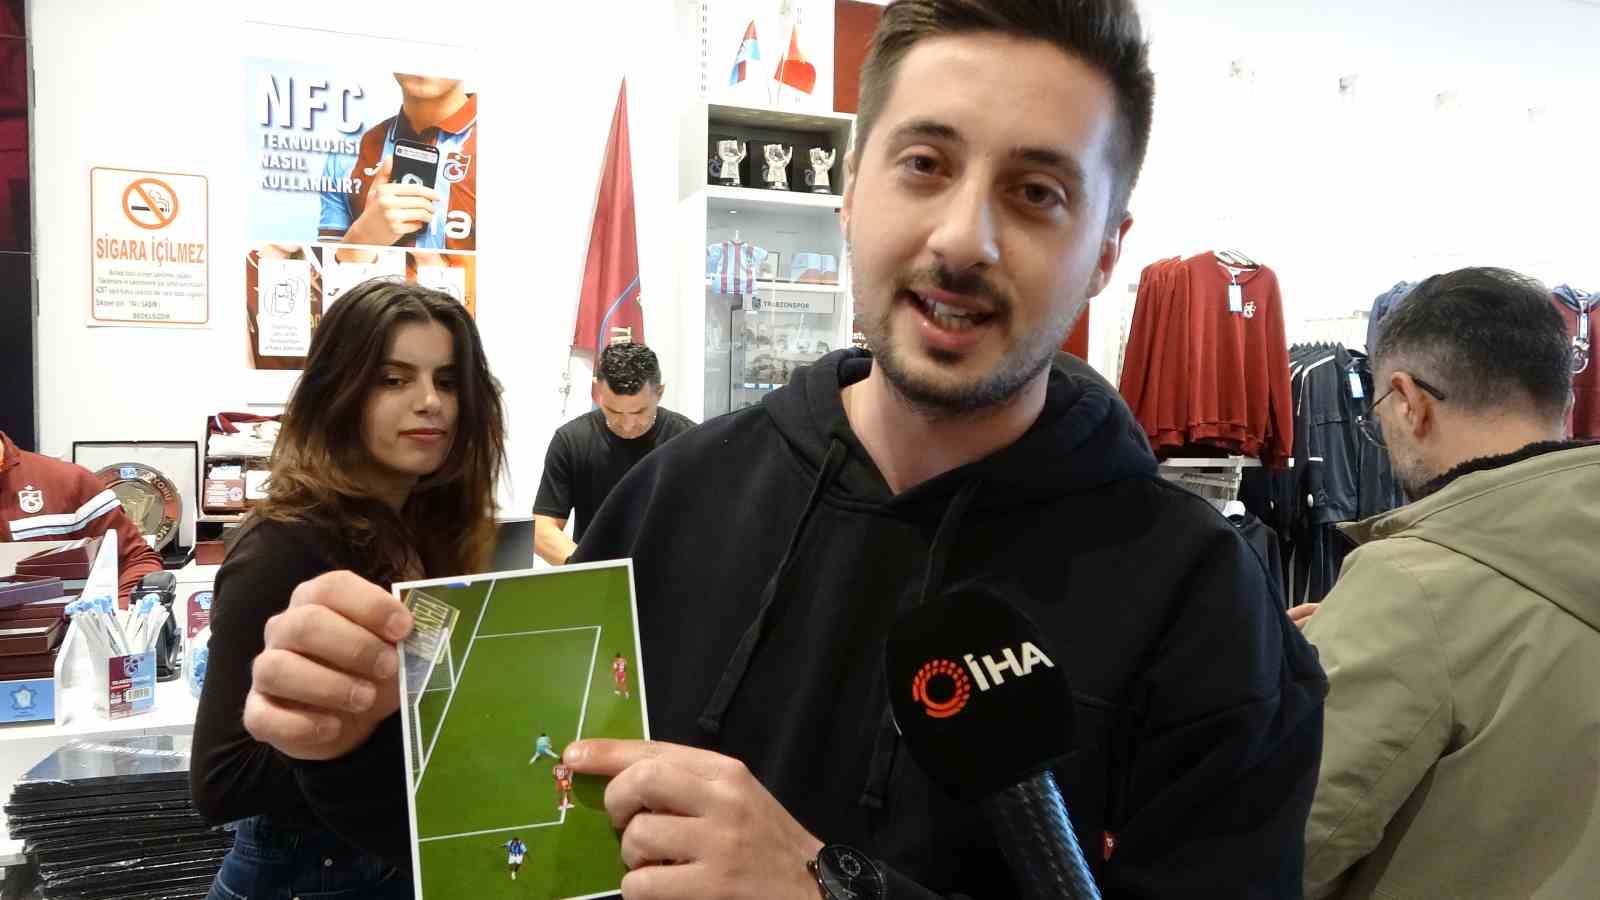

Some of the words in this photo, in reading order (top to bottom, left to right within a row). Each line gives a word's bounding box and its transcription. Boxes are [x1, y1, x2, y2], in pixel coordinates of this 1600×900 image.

[257, 73, 365, 134] NFC
[260, 152, 308, 173] NASIL
[260, 173, 362, 194] KULLANILIR?
[96, 233, 148, 262] SİGARA
[151, 236, 205, 267] İÇİLMEZ
[963, 641, 1055, 692] İHA
